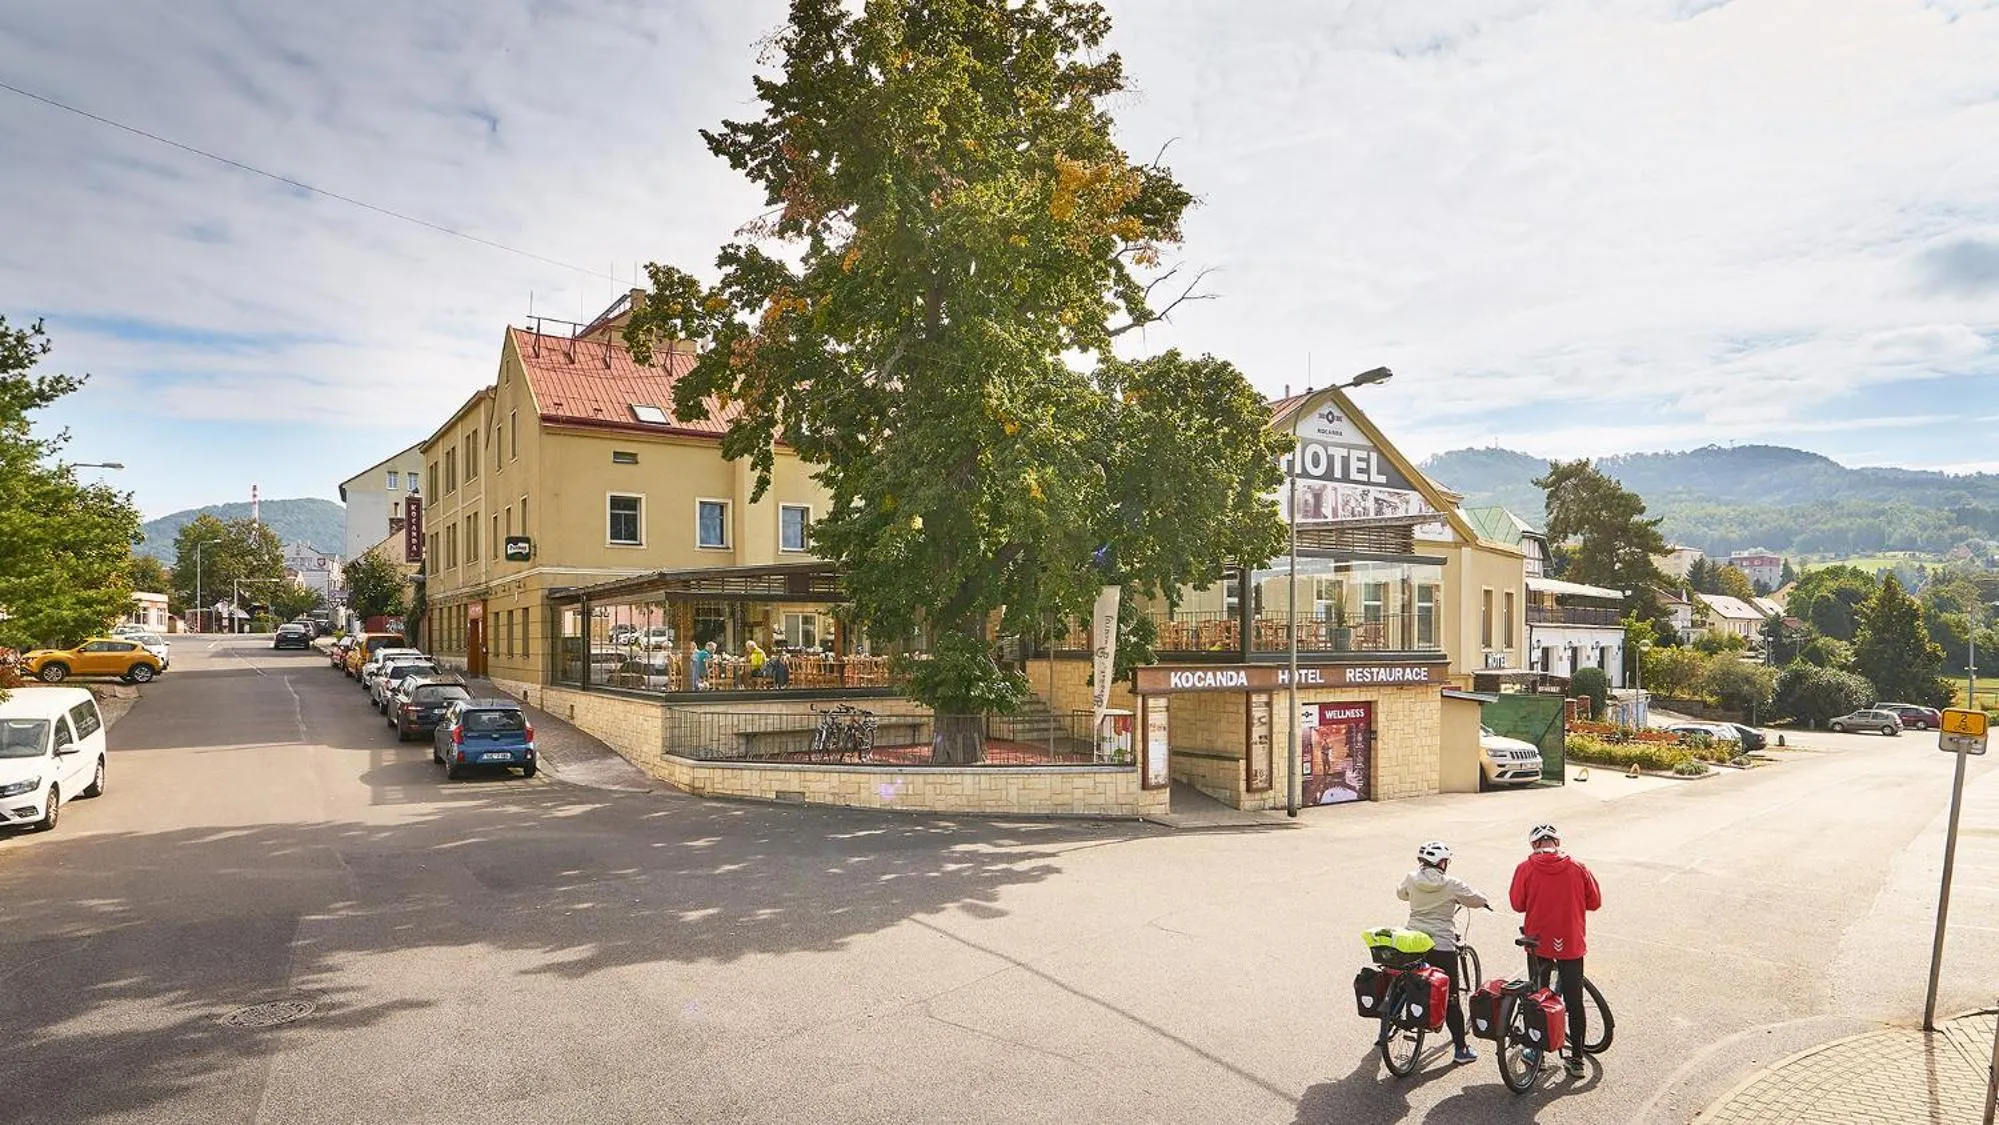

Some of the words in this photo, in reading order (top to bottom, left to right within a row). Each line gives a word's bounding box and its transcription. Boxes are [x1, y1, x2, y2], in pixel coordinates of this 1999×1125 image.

[1280, 443, 1387, 483] HOTEL
[1170, 670, 1248, 688] KOCANDA
[1278, 669, 1325, 684] HOTEL
[1346, 667, 1428, 682] RESTAURACE
[1325, 708, 1365, 719] WELLNESS
[1961, 713, 1968, 722] 2
